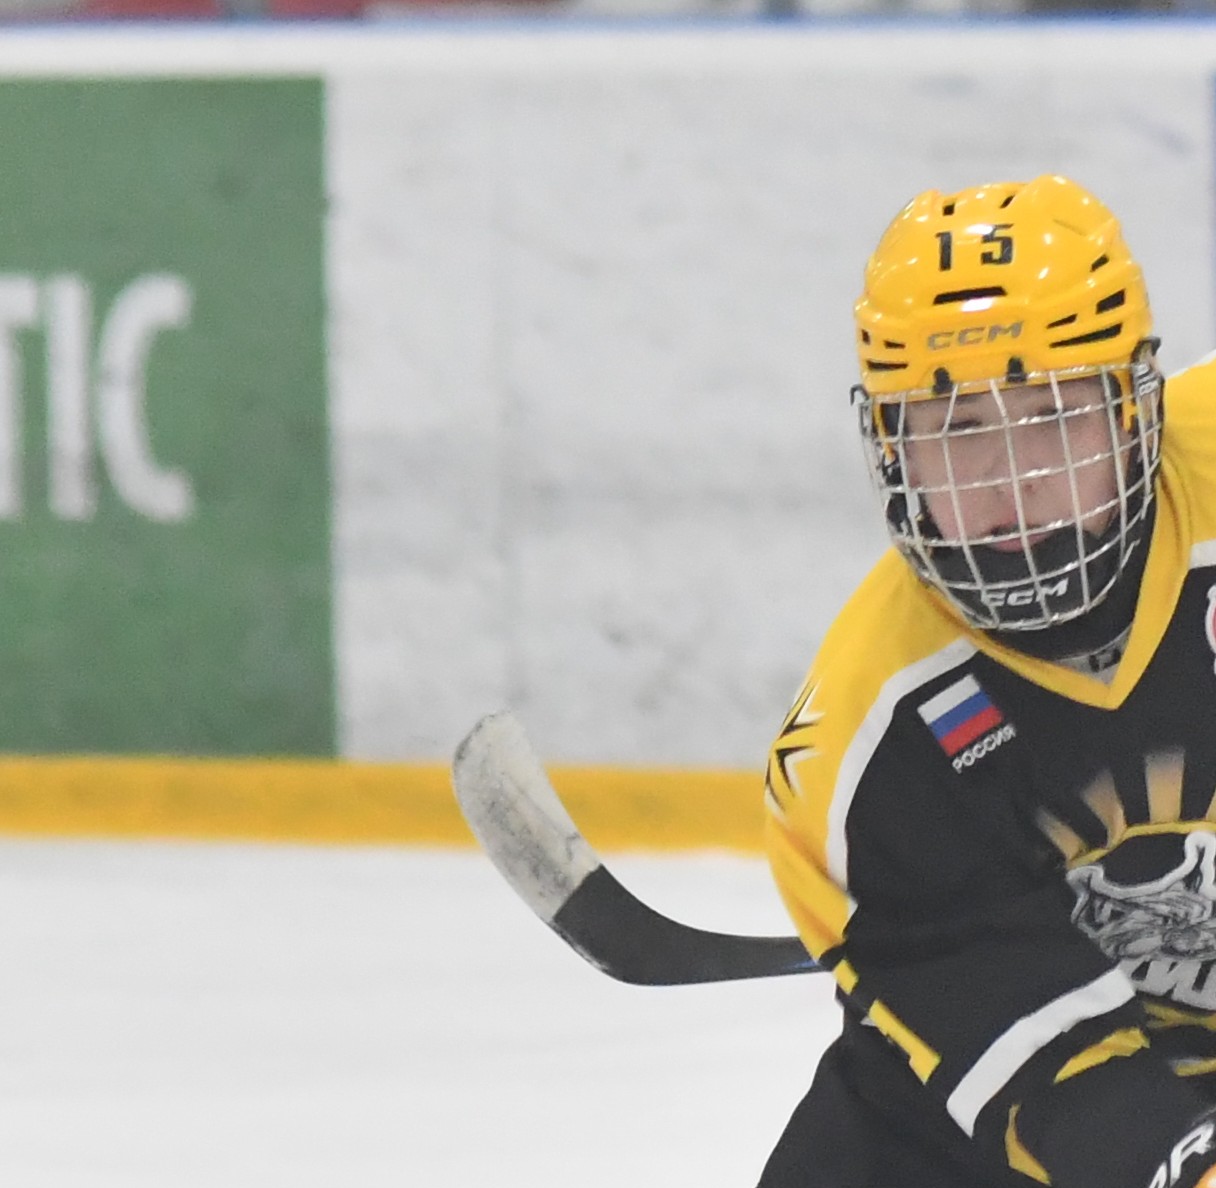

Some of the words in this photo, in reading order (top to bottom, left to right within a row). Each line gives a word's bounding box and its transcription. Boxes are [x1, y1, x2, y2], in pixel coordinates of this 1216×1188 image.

[934, 223, 1014, 271] 15
[927, 320, 1024, 350] CCM
[952, 725, 1017, 774] РОССИЯ
